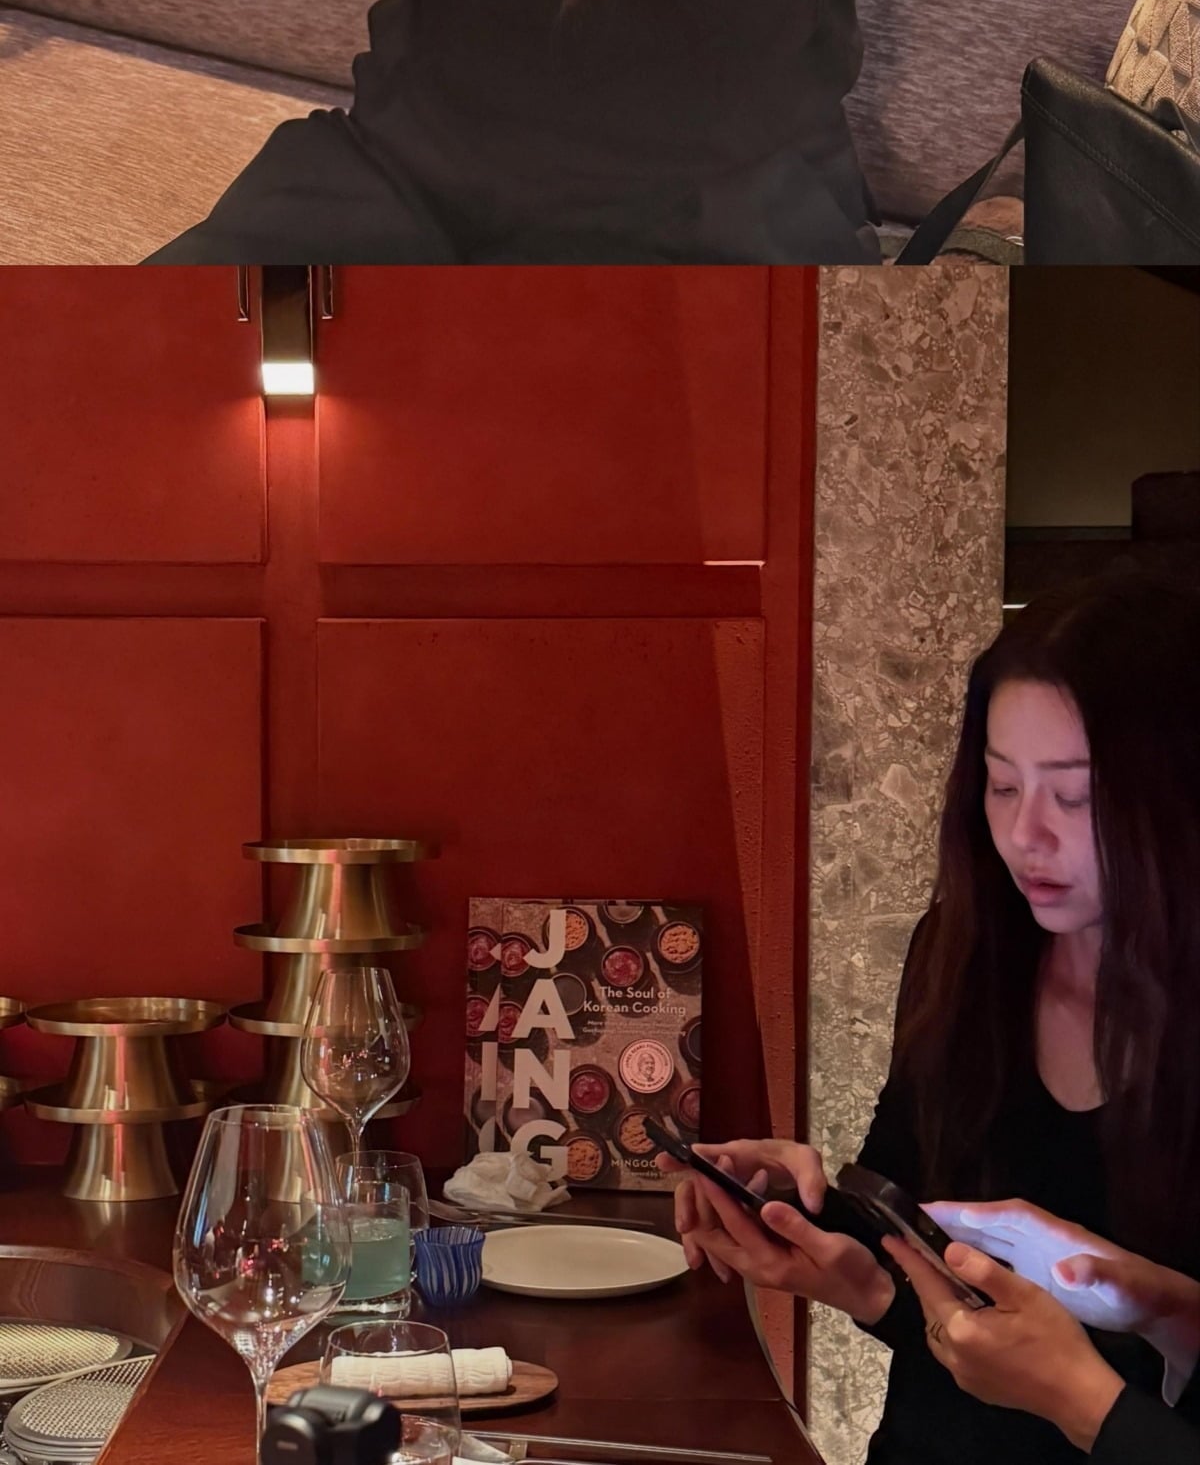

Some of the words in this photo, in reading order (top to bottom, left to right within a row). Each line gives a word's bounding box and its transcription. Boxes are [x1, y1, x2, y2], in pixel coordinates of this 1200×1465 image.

[599, 986, 623, 998] The
[626, 987, 654, 999] Soul
[657, 987, 672, 999] of
[583, 1000, 629, 1013] Korean
[632, 1002, 686, 1017] Cooking
[511, 909, 575, 1182] JANG
